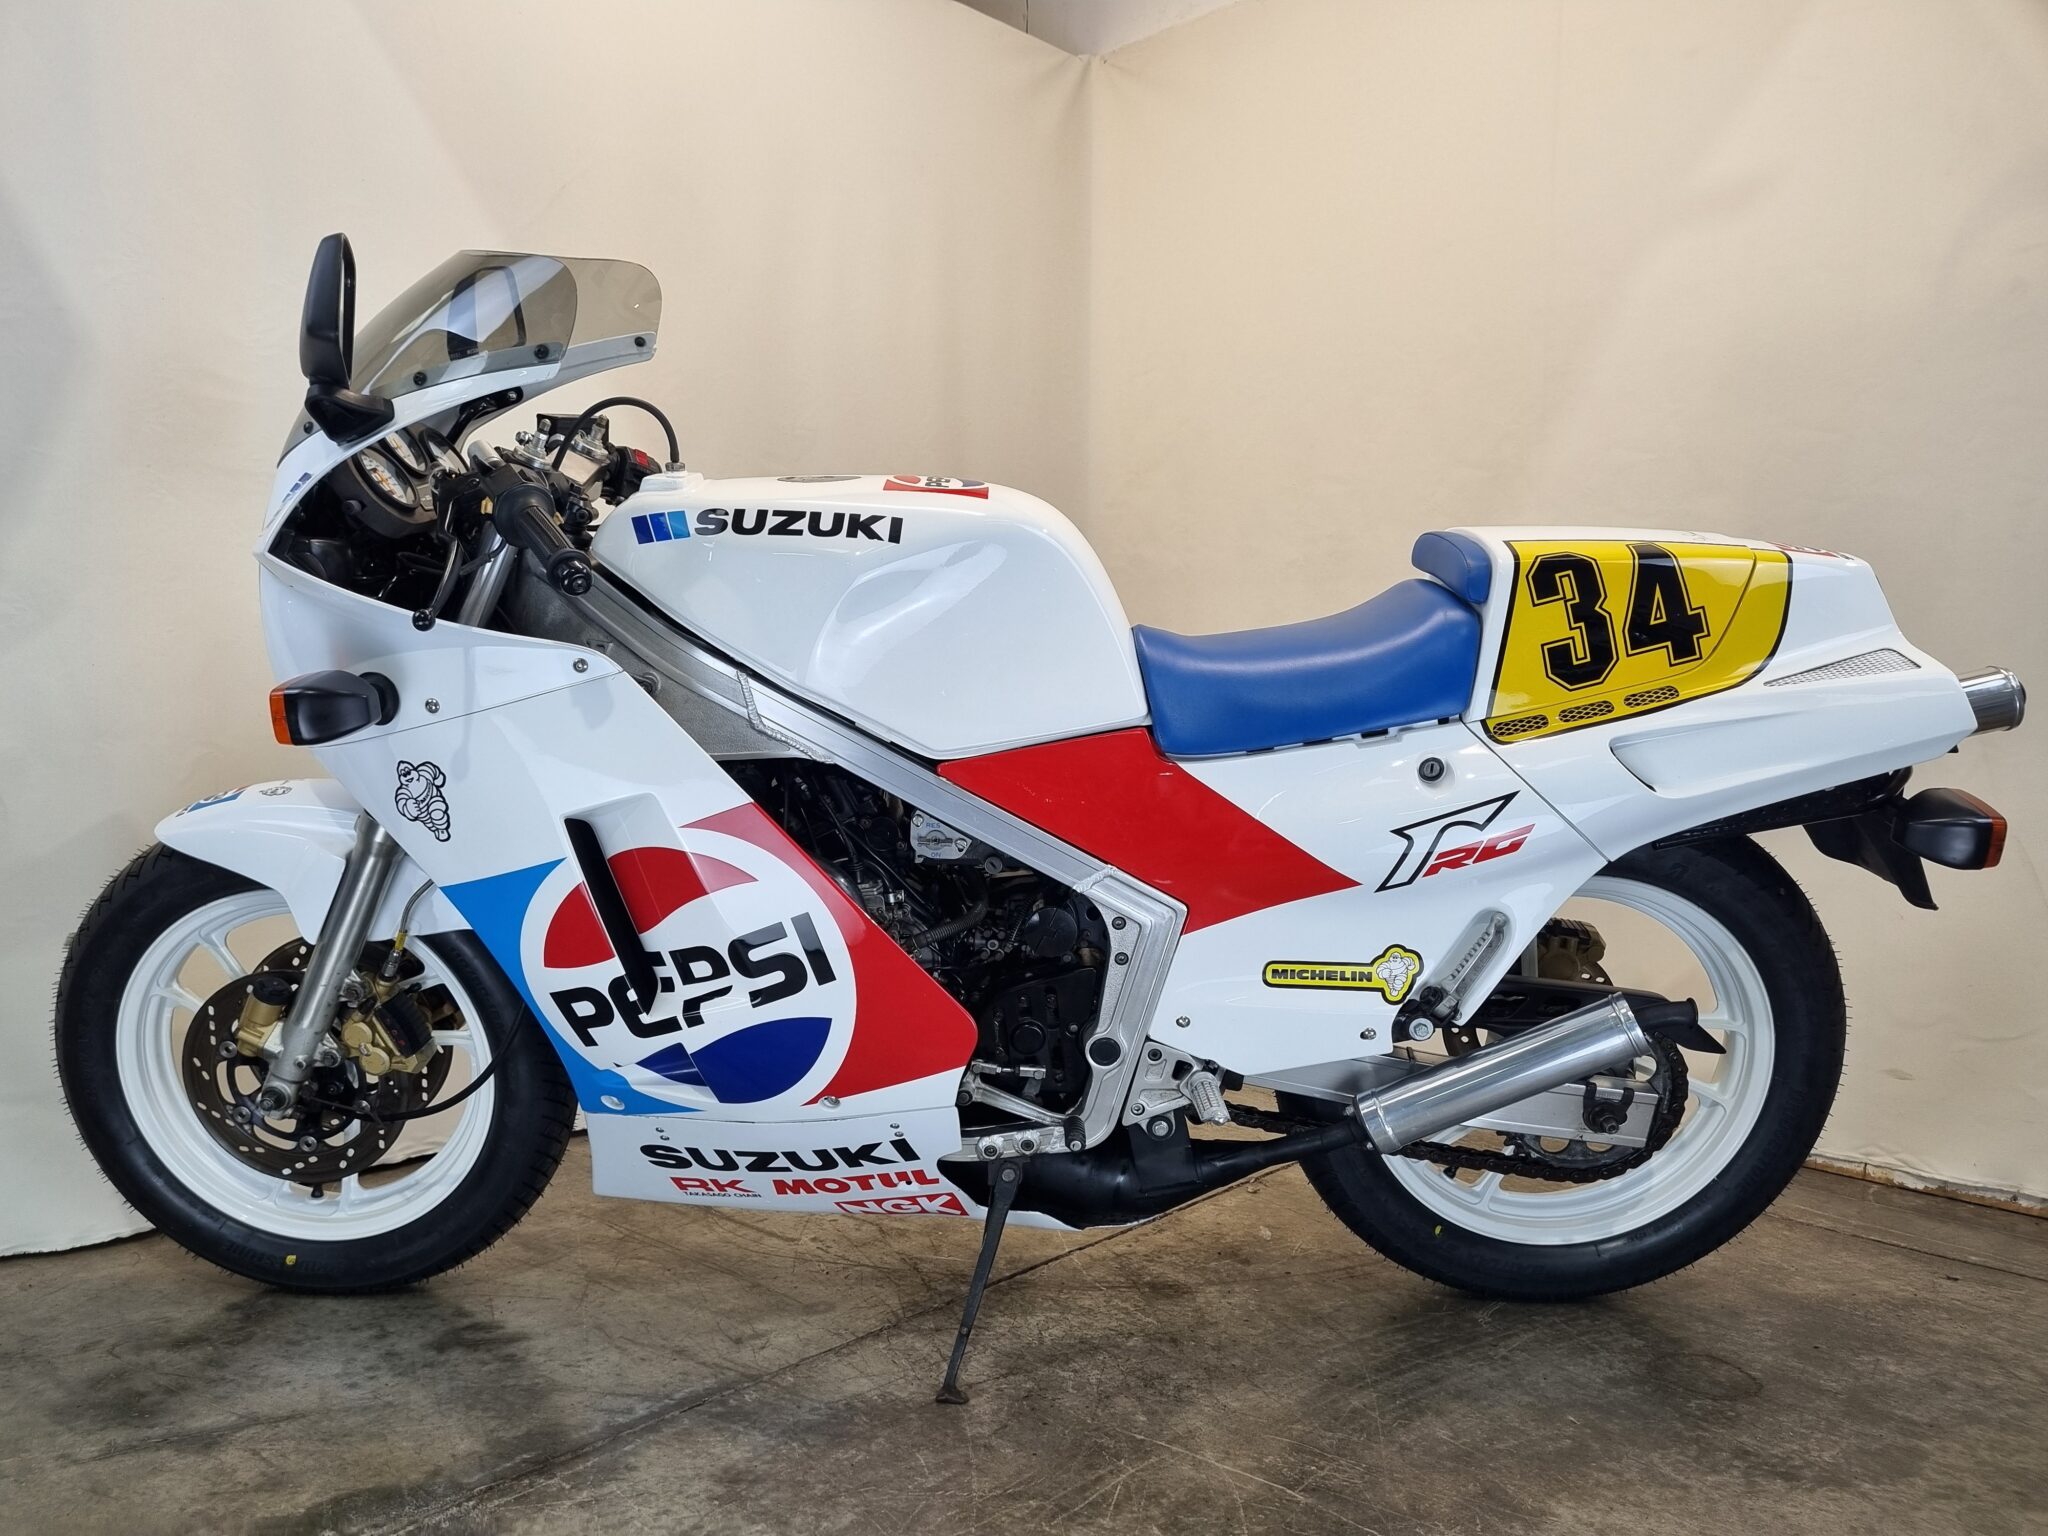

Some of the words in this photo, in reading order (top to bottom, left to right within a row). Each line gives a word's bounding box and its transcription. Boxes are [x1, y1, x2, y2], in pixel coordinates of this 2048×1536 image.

[694, 508, 904, 545] SUZUKI
[1526, 541, 1711, 692] 34
[549, 912, 837, 1048] PEPSI
[1271, 968, 1373, 983] MICHELIN
[639, 1137, 921, 1173] SUZUKI
[669, 1176, 757, 1193] RK
[773, 1169, 940, 1195] MOTUL
[838, 1194, 964, 1215] NGK
